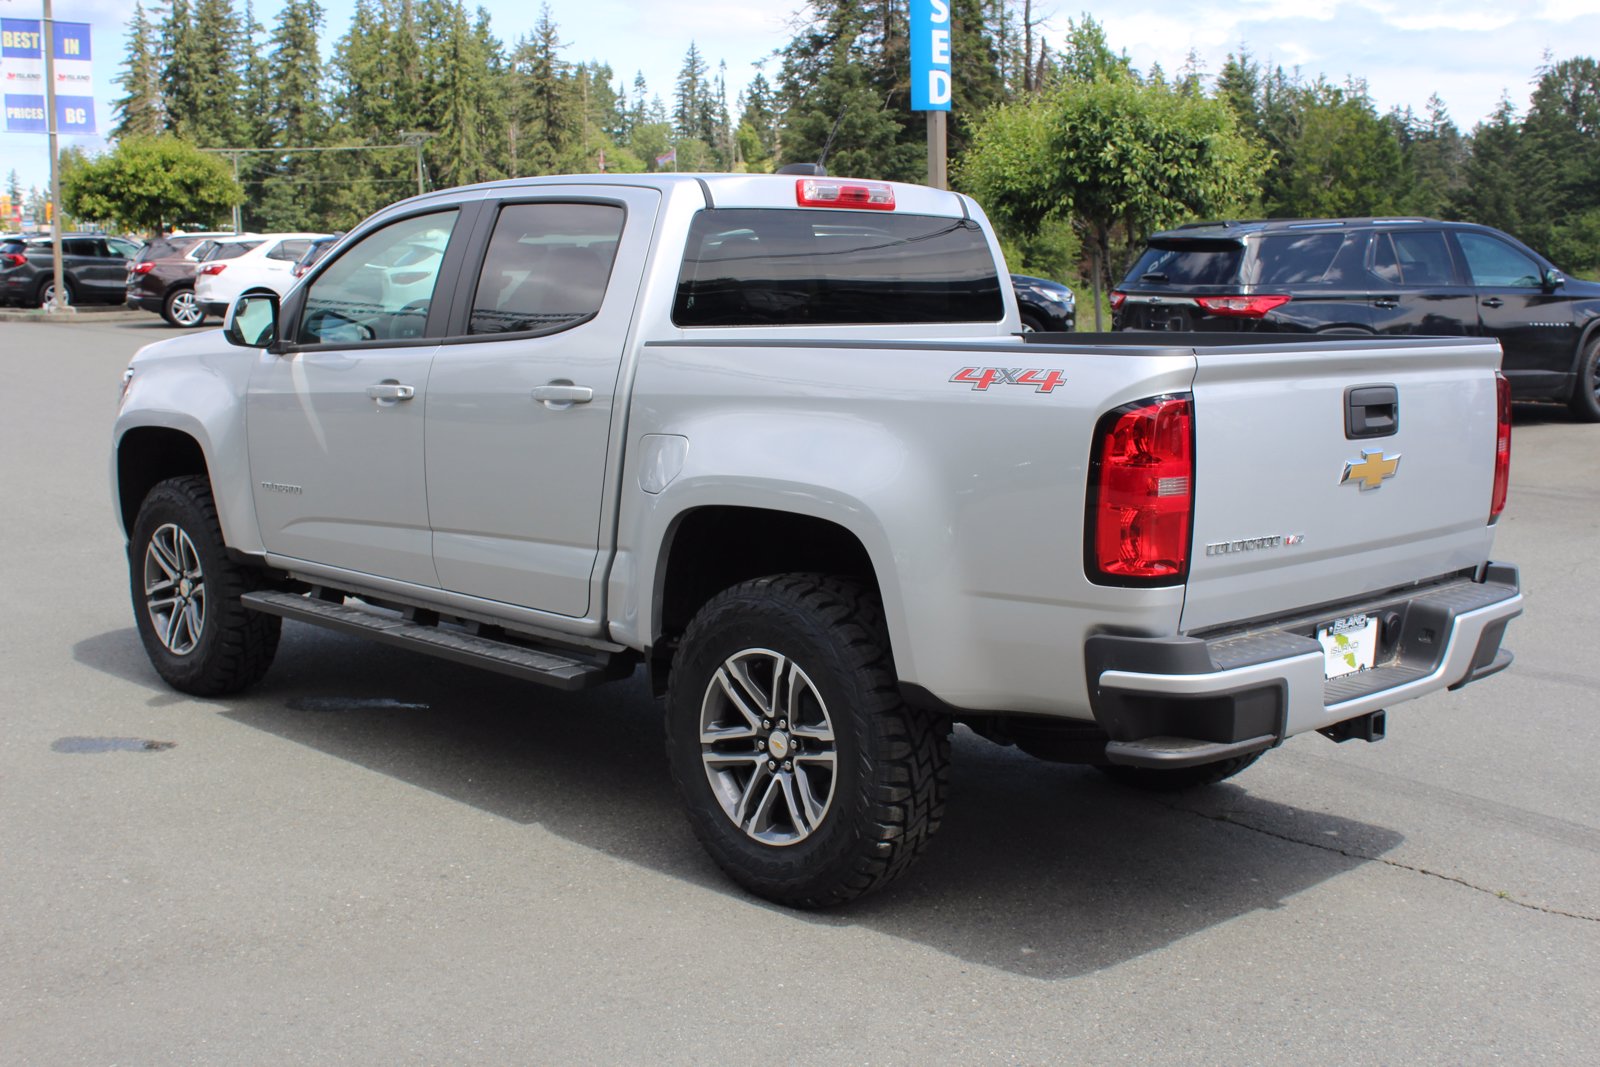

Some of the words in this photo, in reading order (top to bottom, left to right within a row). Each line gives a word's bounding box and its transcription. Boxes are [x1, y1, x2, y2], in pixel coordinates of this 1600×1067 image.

[2, 31, 39, 49] BEST
[64, 38, 79, 55] IN
[6, 107, 44, 119] PRICES
[65, 108, 86, 124] BC
[1334, 614, 1366, 629] ISLAND
[1331, 641, 1359, 656] ISLAND
